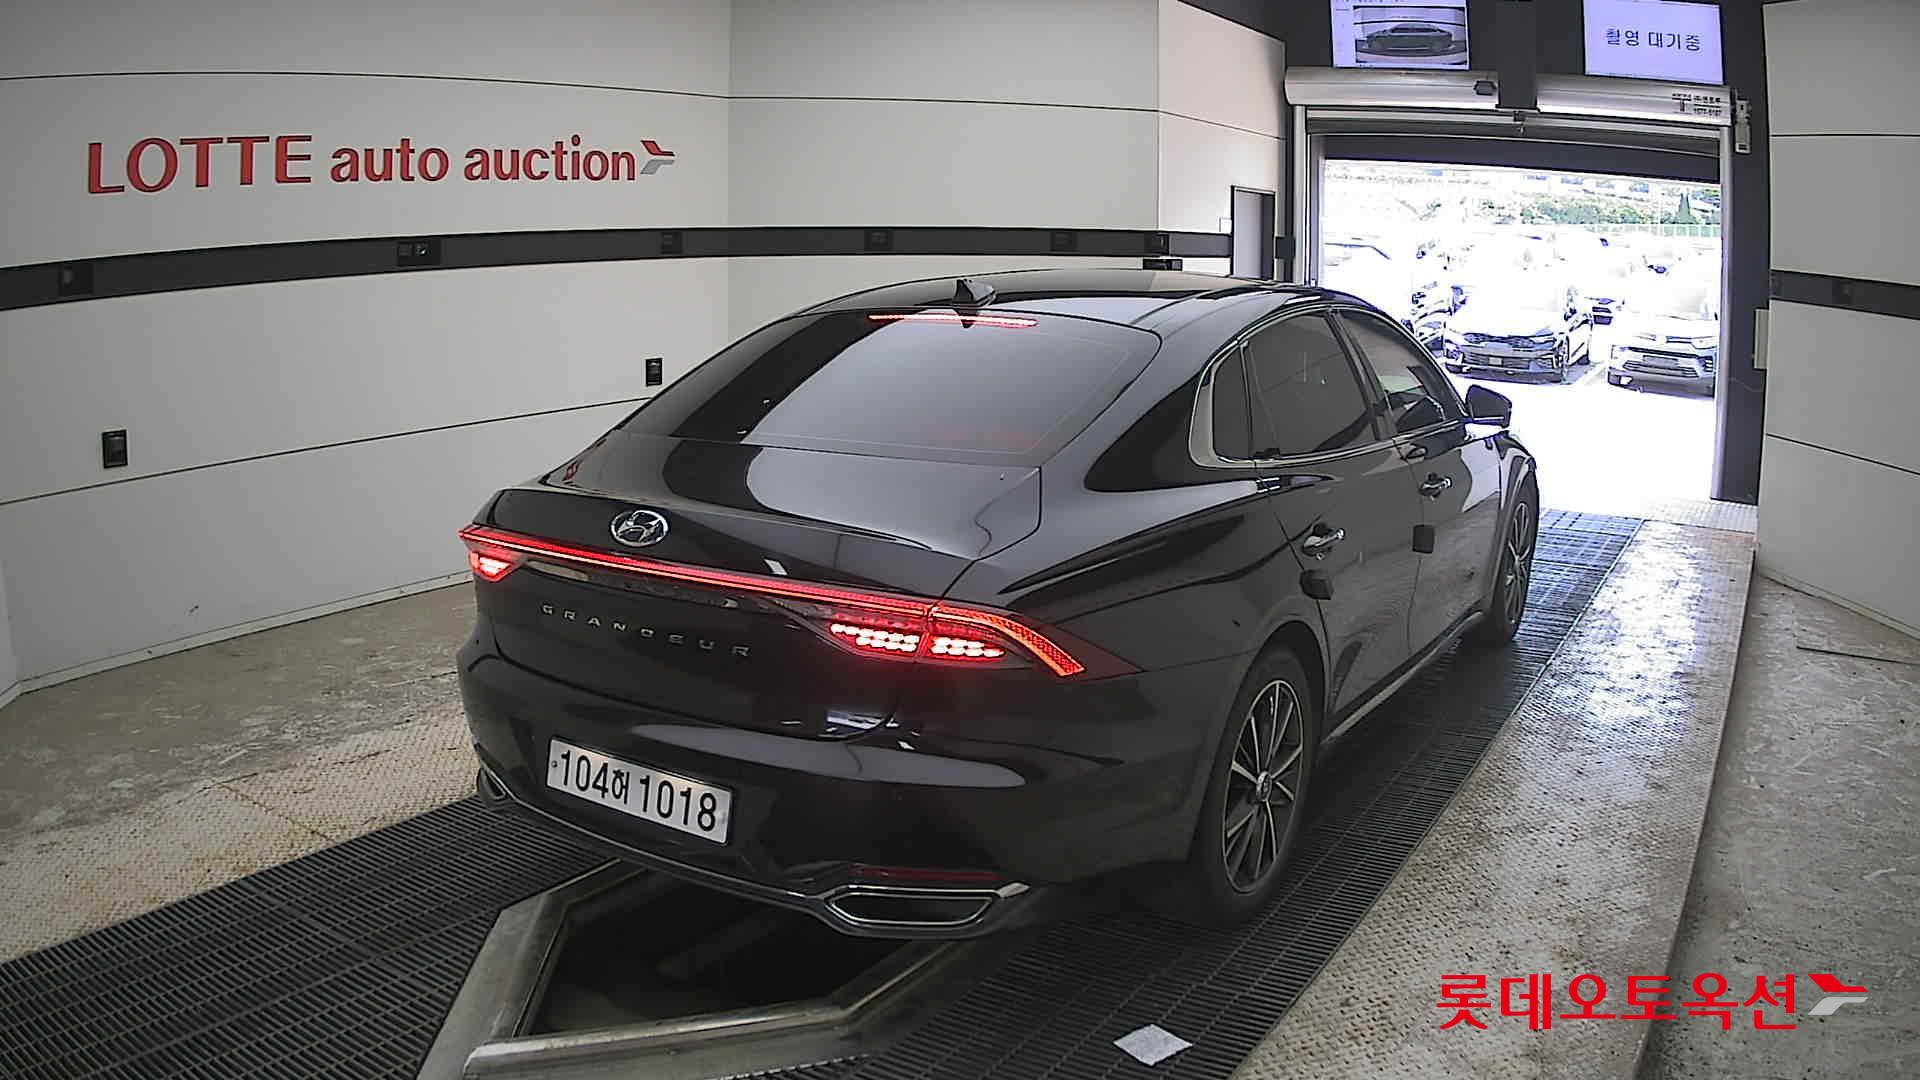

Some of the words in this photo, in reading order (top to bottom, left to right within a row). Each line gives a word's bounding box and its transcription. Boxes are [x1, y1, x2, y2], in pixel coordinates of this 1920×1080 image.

[88, 135, 312, 194] LOTTE
[330, 138, 450, 182] auto
[463, 134, 636, 182] auction
[541, 604, 750, 657] GRANDEUR
[639, 774, 717, 832] 1018
